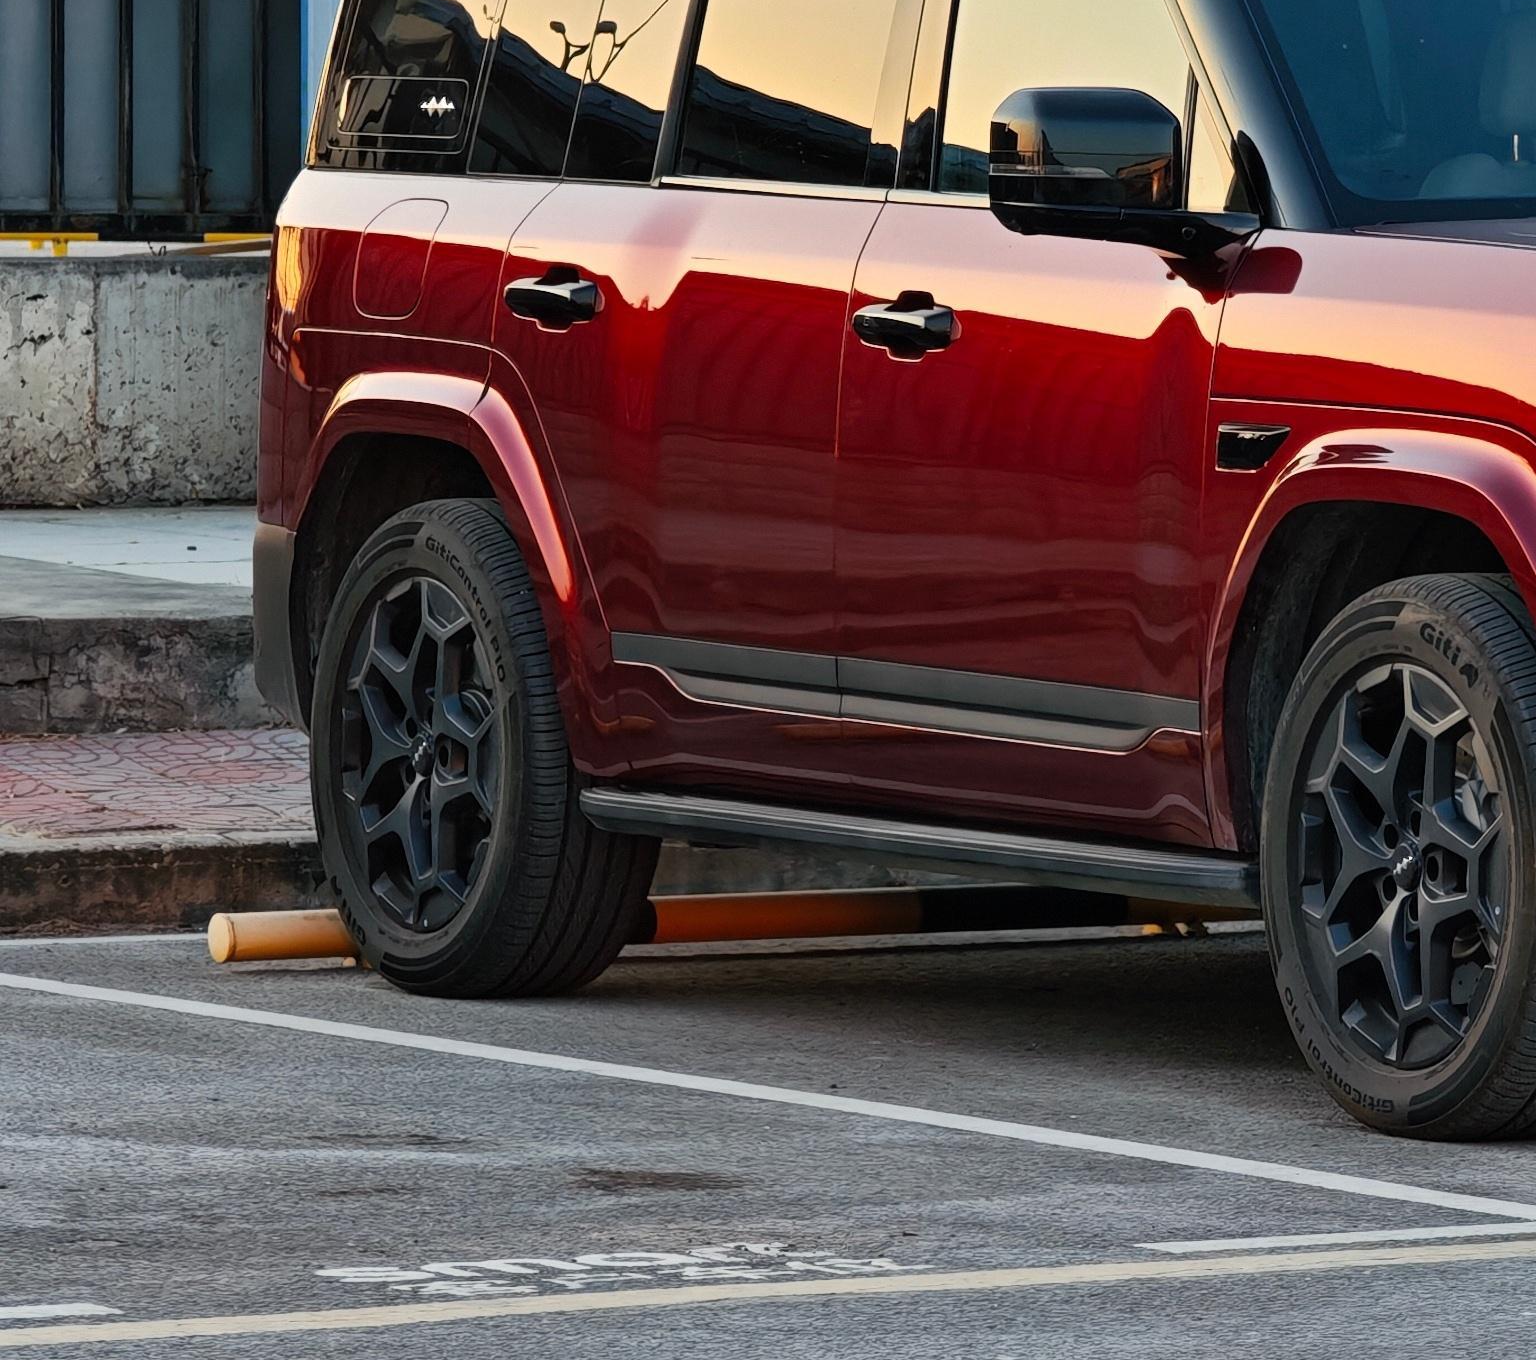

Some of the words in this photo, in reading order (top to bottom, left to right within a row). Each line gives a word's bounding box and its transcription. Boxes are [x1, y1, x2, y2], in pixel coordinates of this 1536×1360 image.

[424, 535, 492, 629] GitiControl
[1419, 622, 1462, 666] Giti
[1306, 1038, 1395, 1113] GitiControl
[315, 1241, 836, 1283] smart
